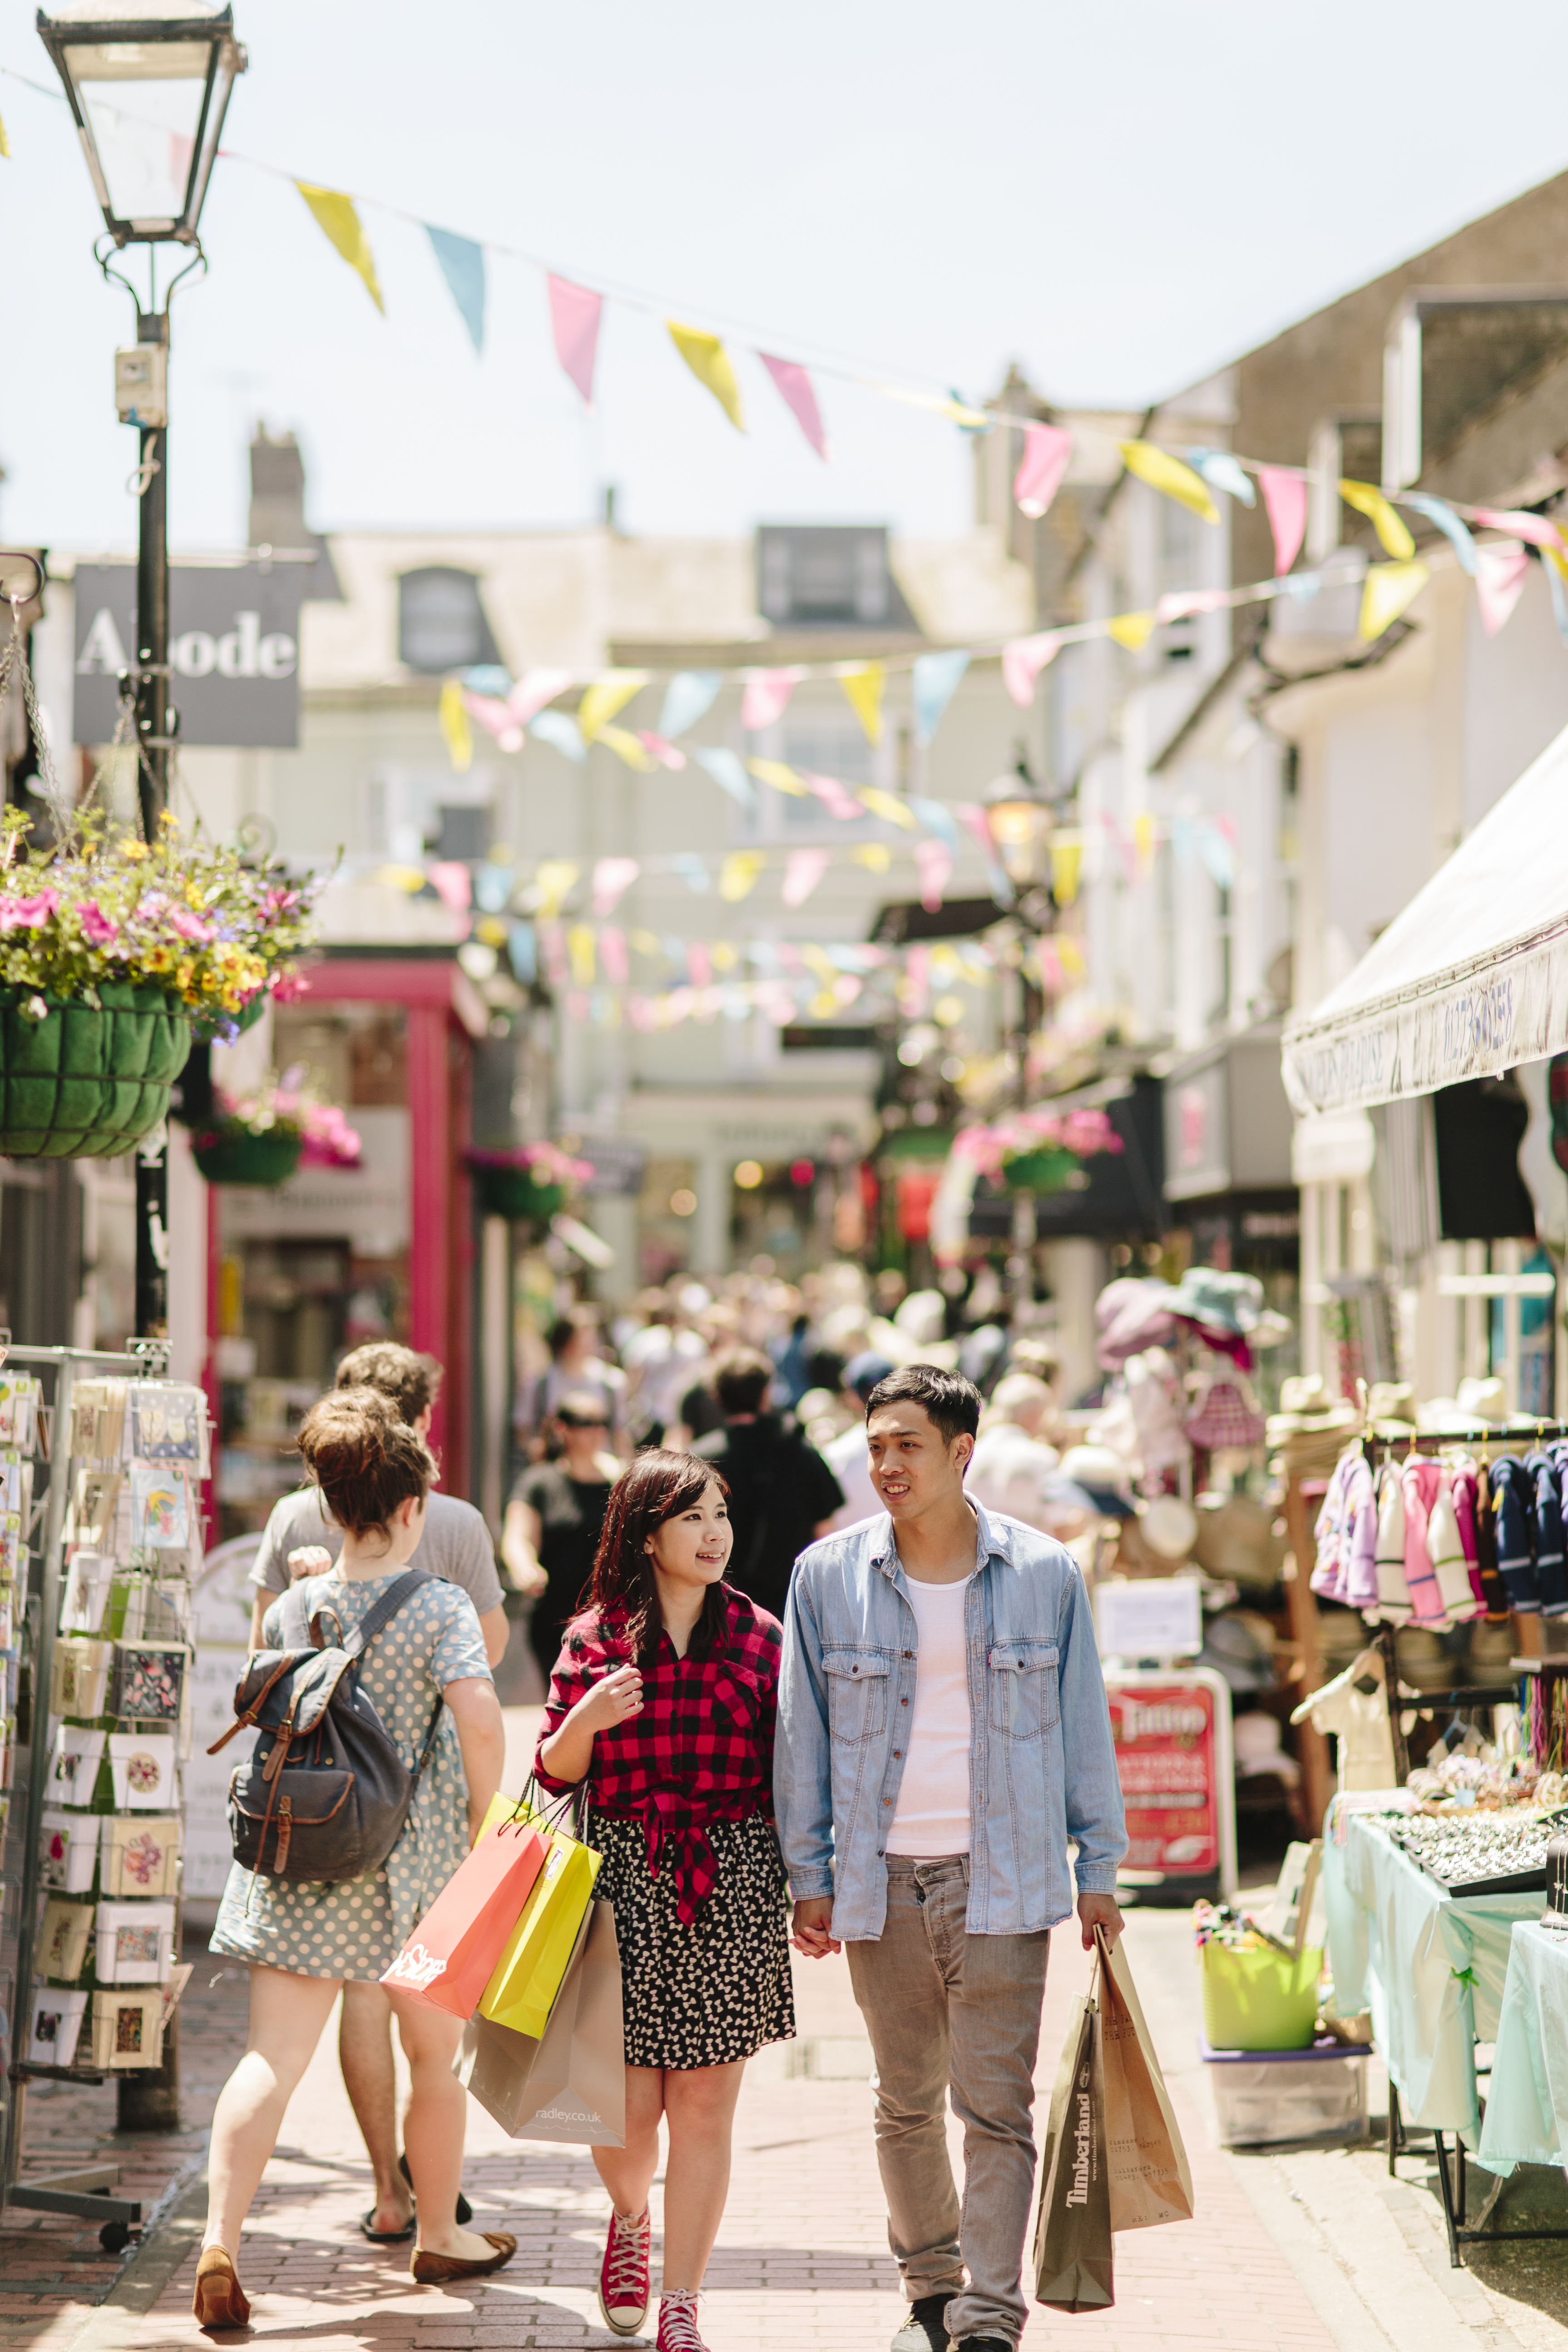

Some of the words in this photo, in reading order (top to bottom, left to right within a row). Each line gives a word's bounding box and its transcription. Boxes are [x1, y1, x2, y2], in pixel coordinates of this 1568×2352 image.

[76, 608, 297, 679] Aode
[535, 2108, 602, 2123] radley.co.uk
[1065, 2093, 1090, 2208] Timberland
